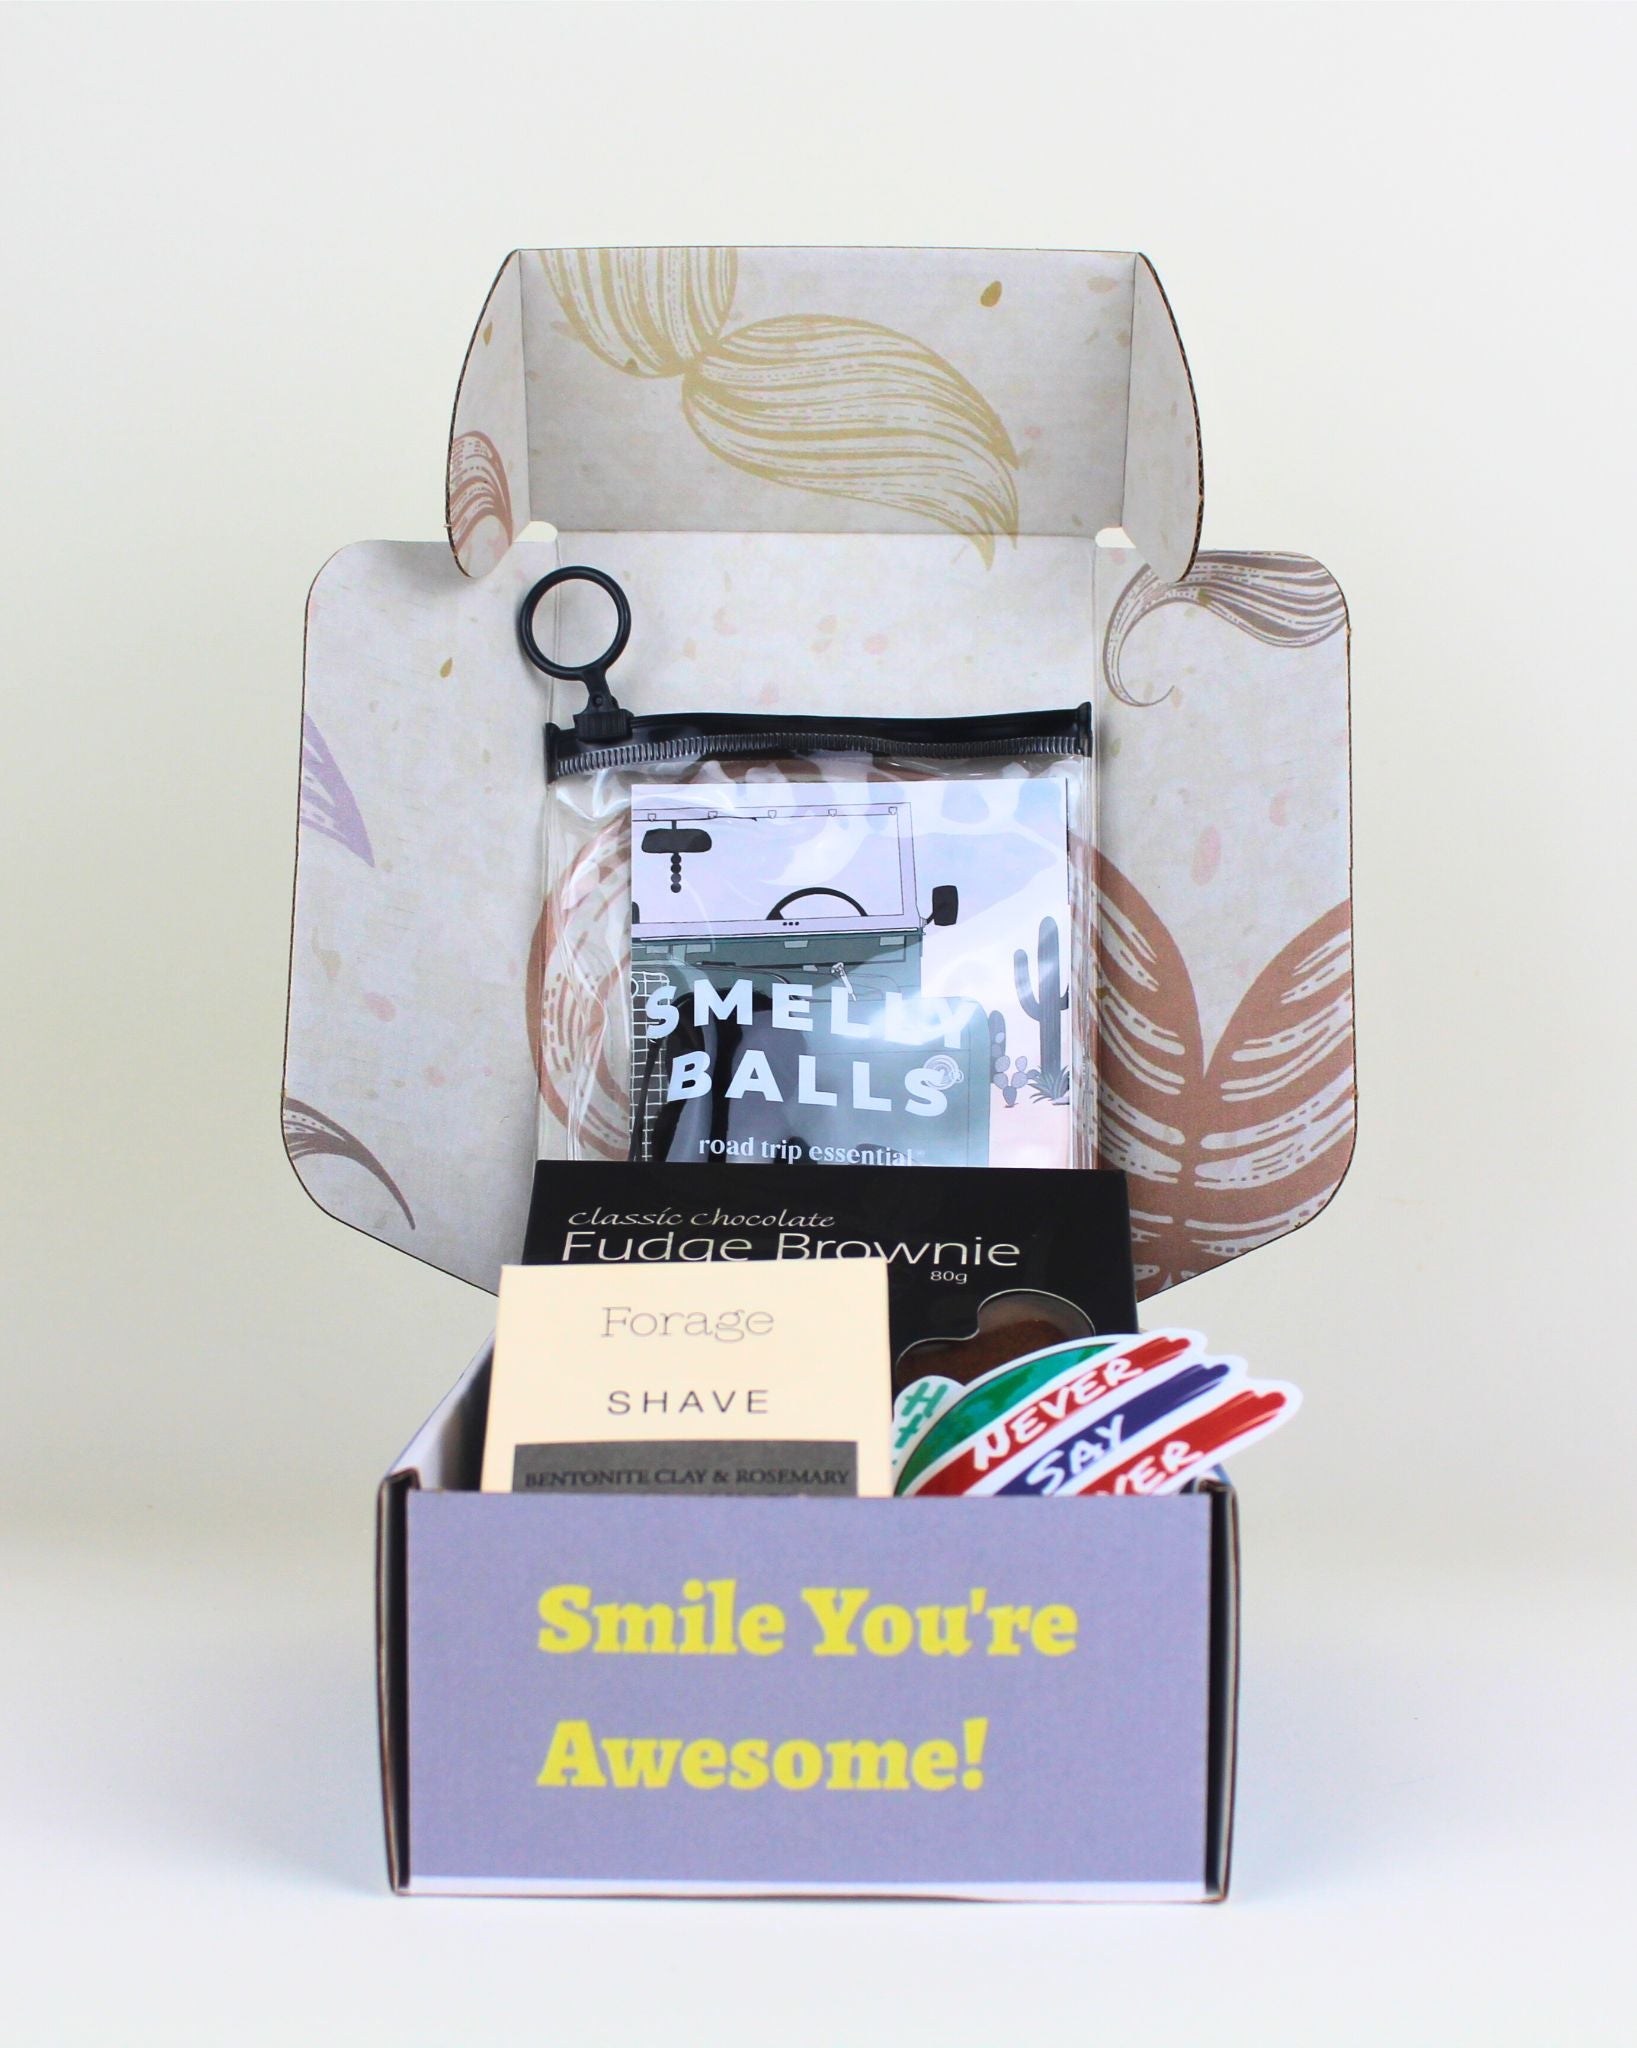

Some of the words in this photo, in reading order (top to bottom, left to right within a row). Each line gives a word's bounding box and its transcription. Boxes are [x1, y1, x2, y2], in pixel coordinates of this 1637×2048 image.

[644, 977, 980, 1049] SMELLY
[667, 1049, 950, 1117] BALLS
[699, 1136, 754, 1156] road
[760, 1139, 802, 1164] trip
[808, 1143, 912, 1166] essential
[568, 1207, 683, 1226] classic
[690, 1208, 835, 1228] chocolate
[561, 1231, 753, 1262] Fudge
[776, 1233, 1021, 1266] Brownie
[930, 1270, 968, 1285] 80g
[600, 1306, 774, 1342] Forage
[607, 1390, 770, 1415] SHAVE
[972, 1357, 1142, 1471] NEVER
[1026, 1414, 1124, 1494] SAY
[524, 1470, 649, 1488] BENTONITE
[653, 1468, 707, 1485] CLAY
[712, 1469, 729, 1484] &
[736, 1468, 849, 1485] ROSEMARY
[537, 1579, 785, 1656] Smile
[802, 1588, 1078, 1657] You're
[537, 1717, 989, 1791] Awesome!
